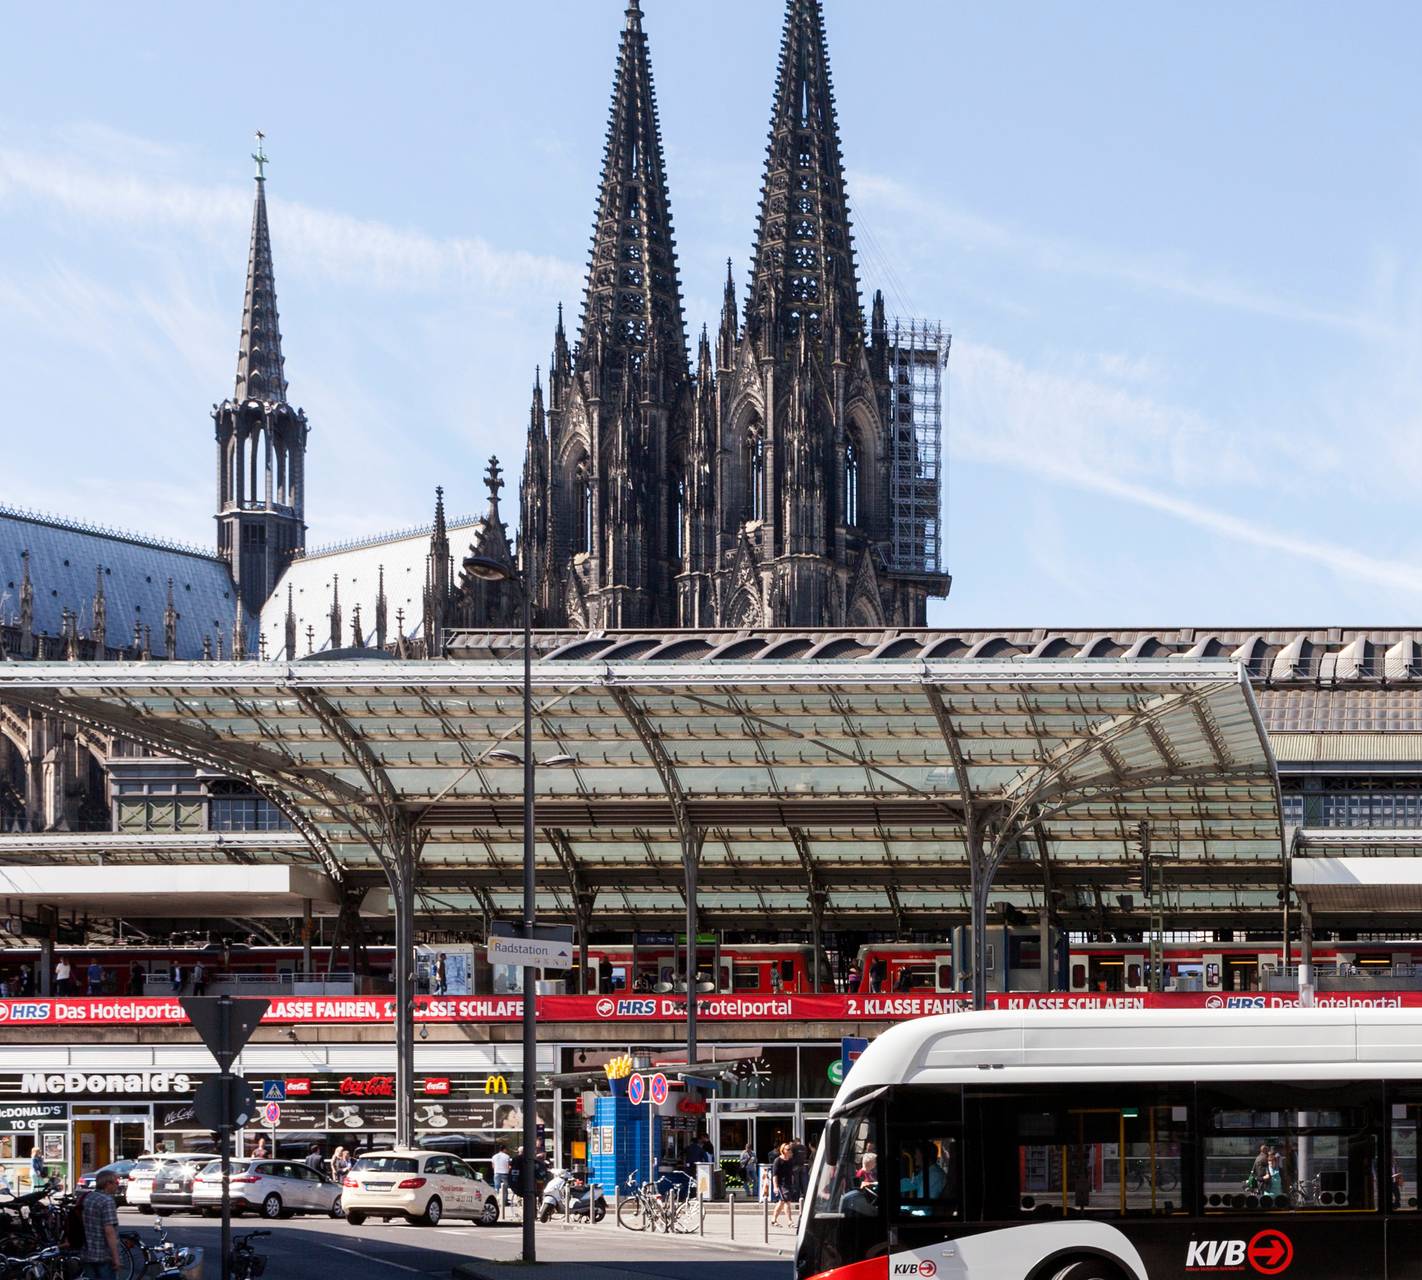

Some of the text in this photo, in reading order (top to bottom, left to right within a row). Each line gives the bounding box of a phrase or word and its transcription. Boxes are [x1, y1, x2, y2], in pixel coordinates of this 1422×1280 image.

[495, 942, 548, 956] Radstation
[263, 1002, 313, 1018] LASSE
[316, 1002, 380, 1019] FAHREN,
[459, 1002, 540, 1017] SCHLAFE.
[617, 1000, 656, 1016] HRS
[848, 1000, 861, 1015] 2.
[864, 1000, 921, 1014] KLASSE
[1227, 997, 1266, 1009] HRS
[1271, 997, 1300, 1009] Das
[11, 1004, 51, 1019] HRS
[55, 1004, 86, 1019] Das
[21, 1072, 190, 1094] McDonald's
[10, 1119, 26, 1130] TO
[1185, 1240, 1247, 1267] KVB
[894, 1263, 918, 1274] KVB
